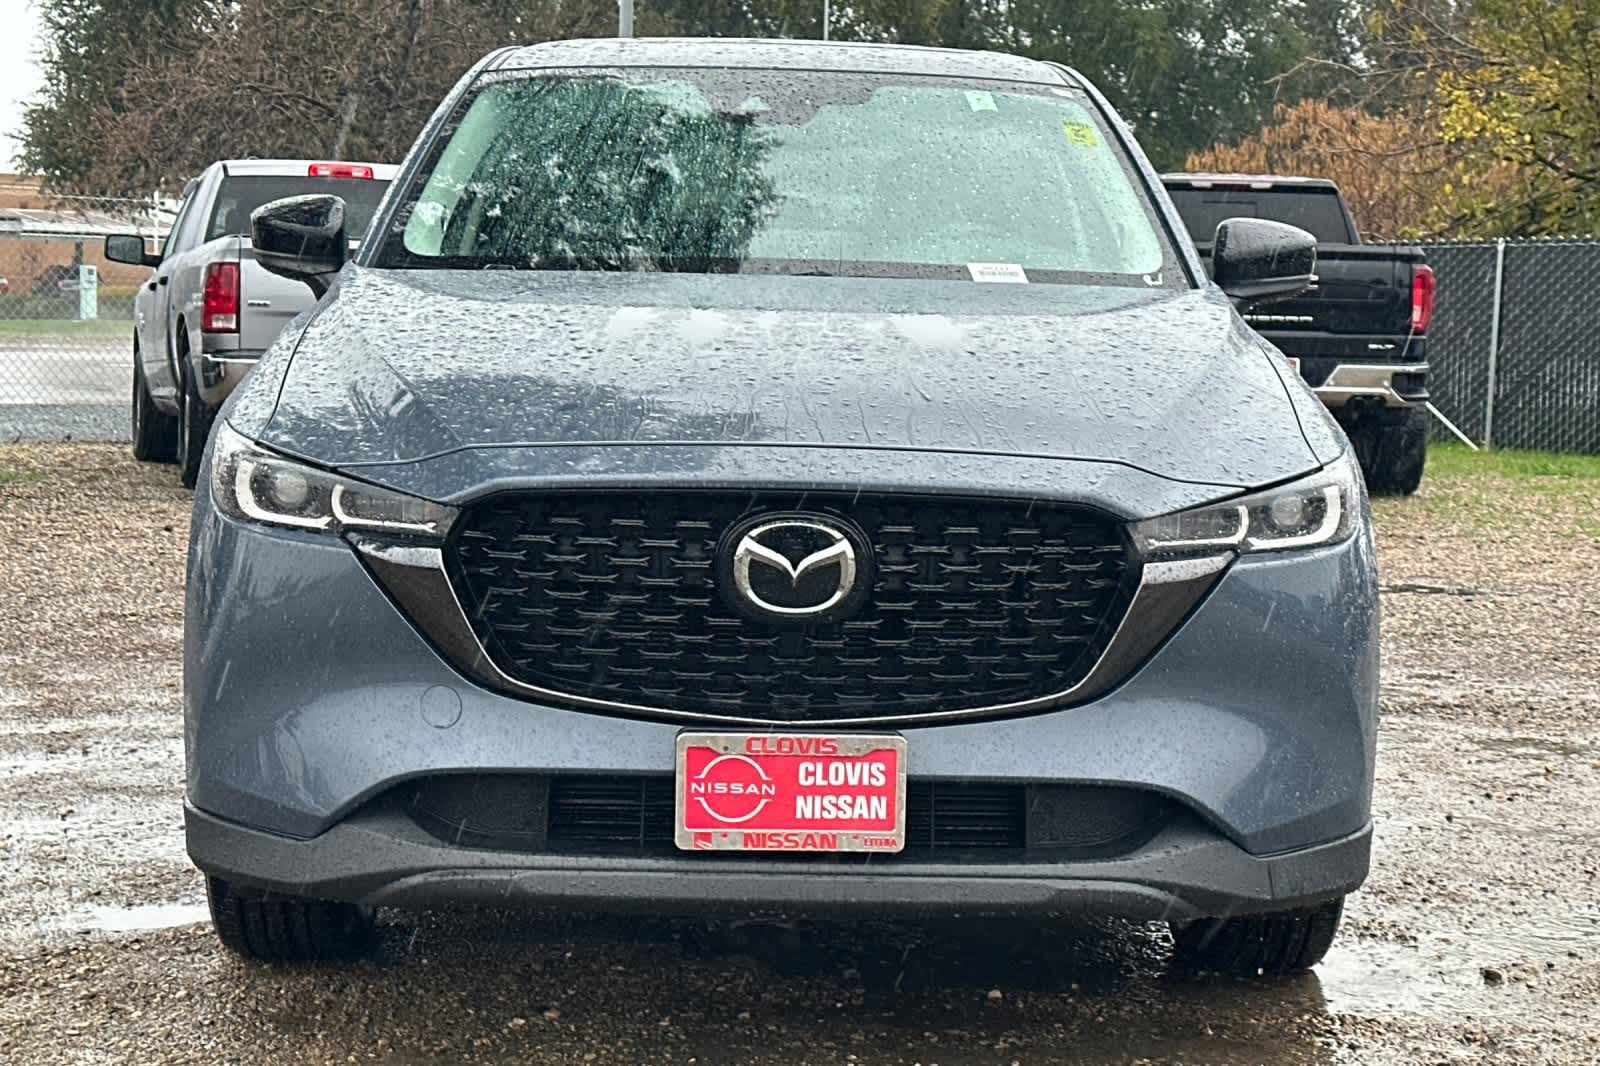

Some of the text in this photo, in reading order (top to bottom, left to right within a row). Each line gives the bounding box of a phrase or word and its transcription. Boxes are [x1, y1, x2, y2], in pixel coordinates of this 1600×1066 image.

[745, 736, 839, 754] CLOVIS
[798, 761, 886, 787] CLOVIS
[690, 782, 776, 795] NISSAN
[795, 794, 887, 820] NISSAN
[743, 832, 839, 849] NISSAN
